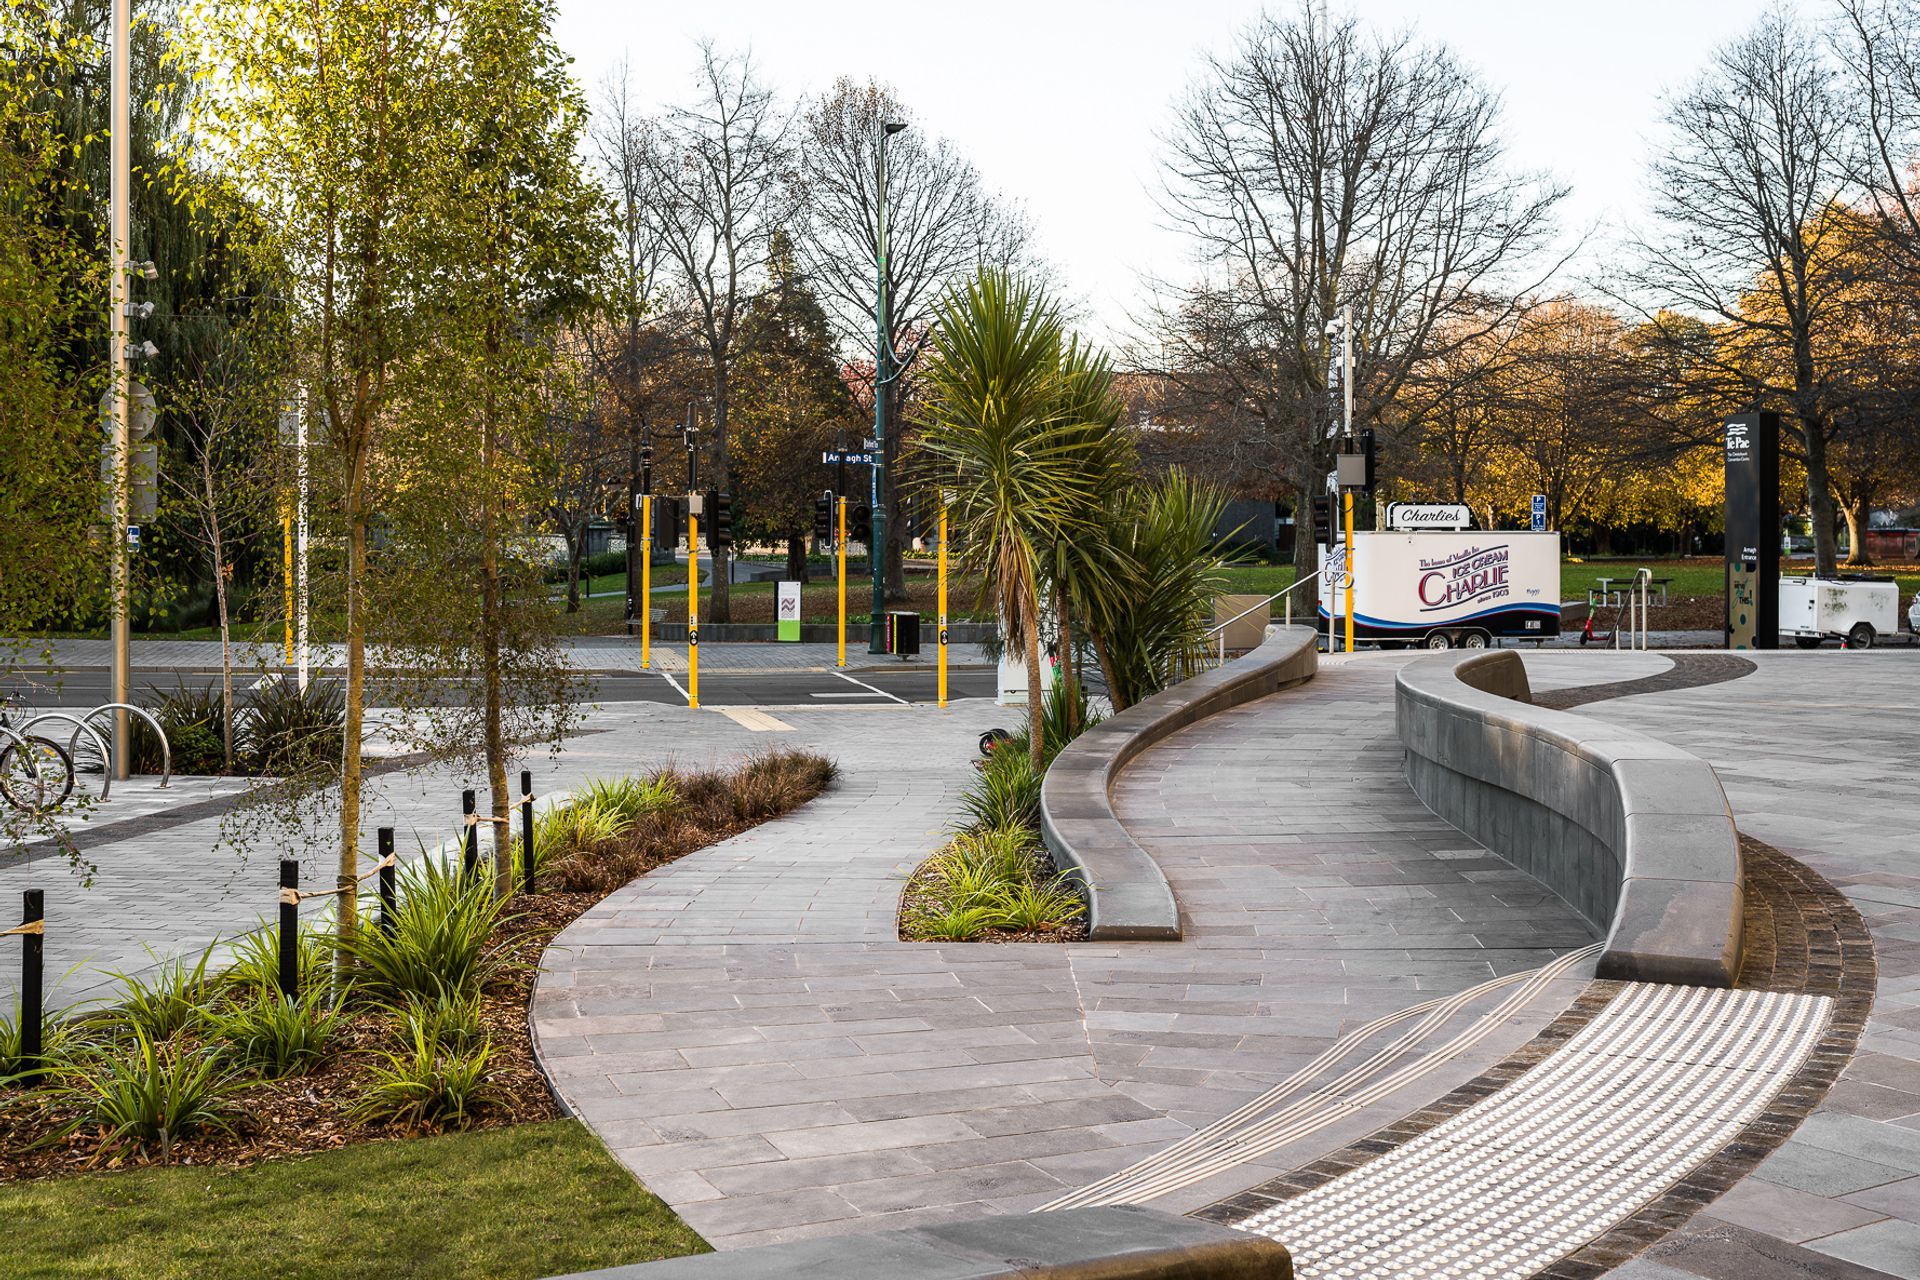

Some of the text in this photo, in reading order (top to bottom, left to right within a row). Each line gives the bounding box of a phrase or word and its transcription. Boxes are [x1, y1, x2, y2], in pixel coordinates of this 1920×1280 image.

[1726, 437, 1750, 449] Te Pae
[828, 454, 872, 464] Aragh St
[1402, 508, 1460, 521] Charlies
[1420, 559, 1430, 567] The
[1446, 554, 1453, 563] of
[1453, 550, 1508, 578] ICE CREAM
[1418, 565, 1509, 607] CHARLIE
[1492, 588, 1509, 599] 1903
